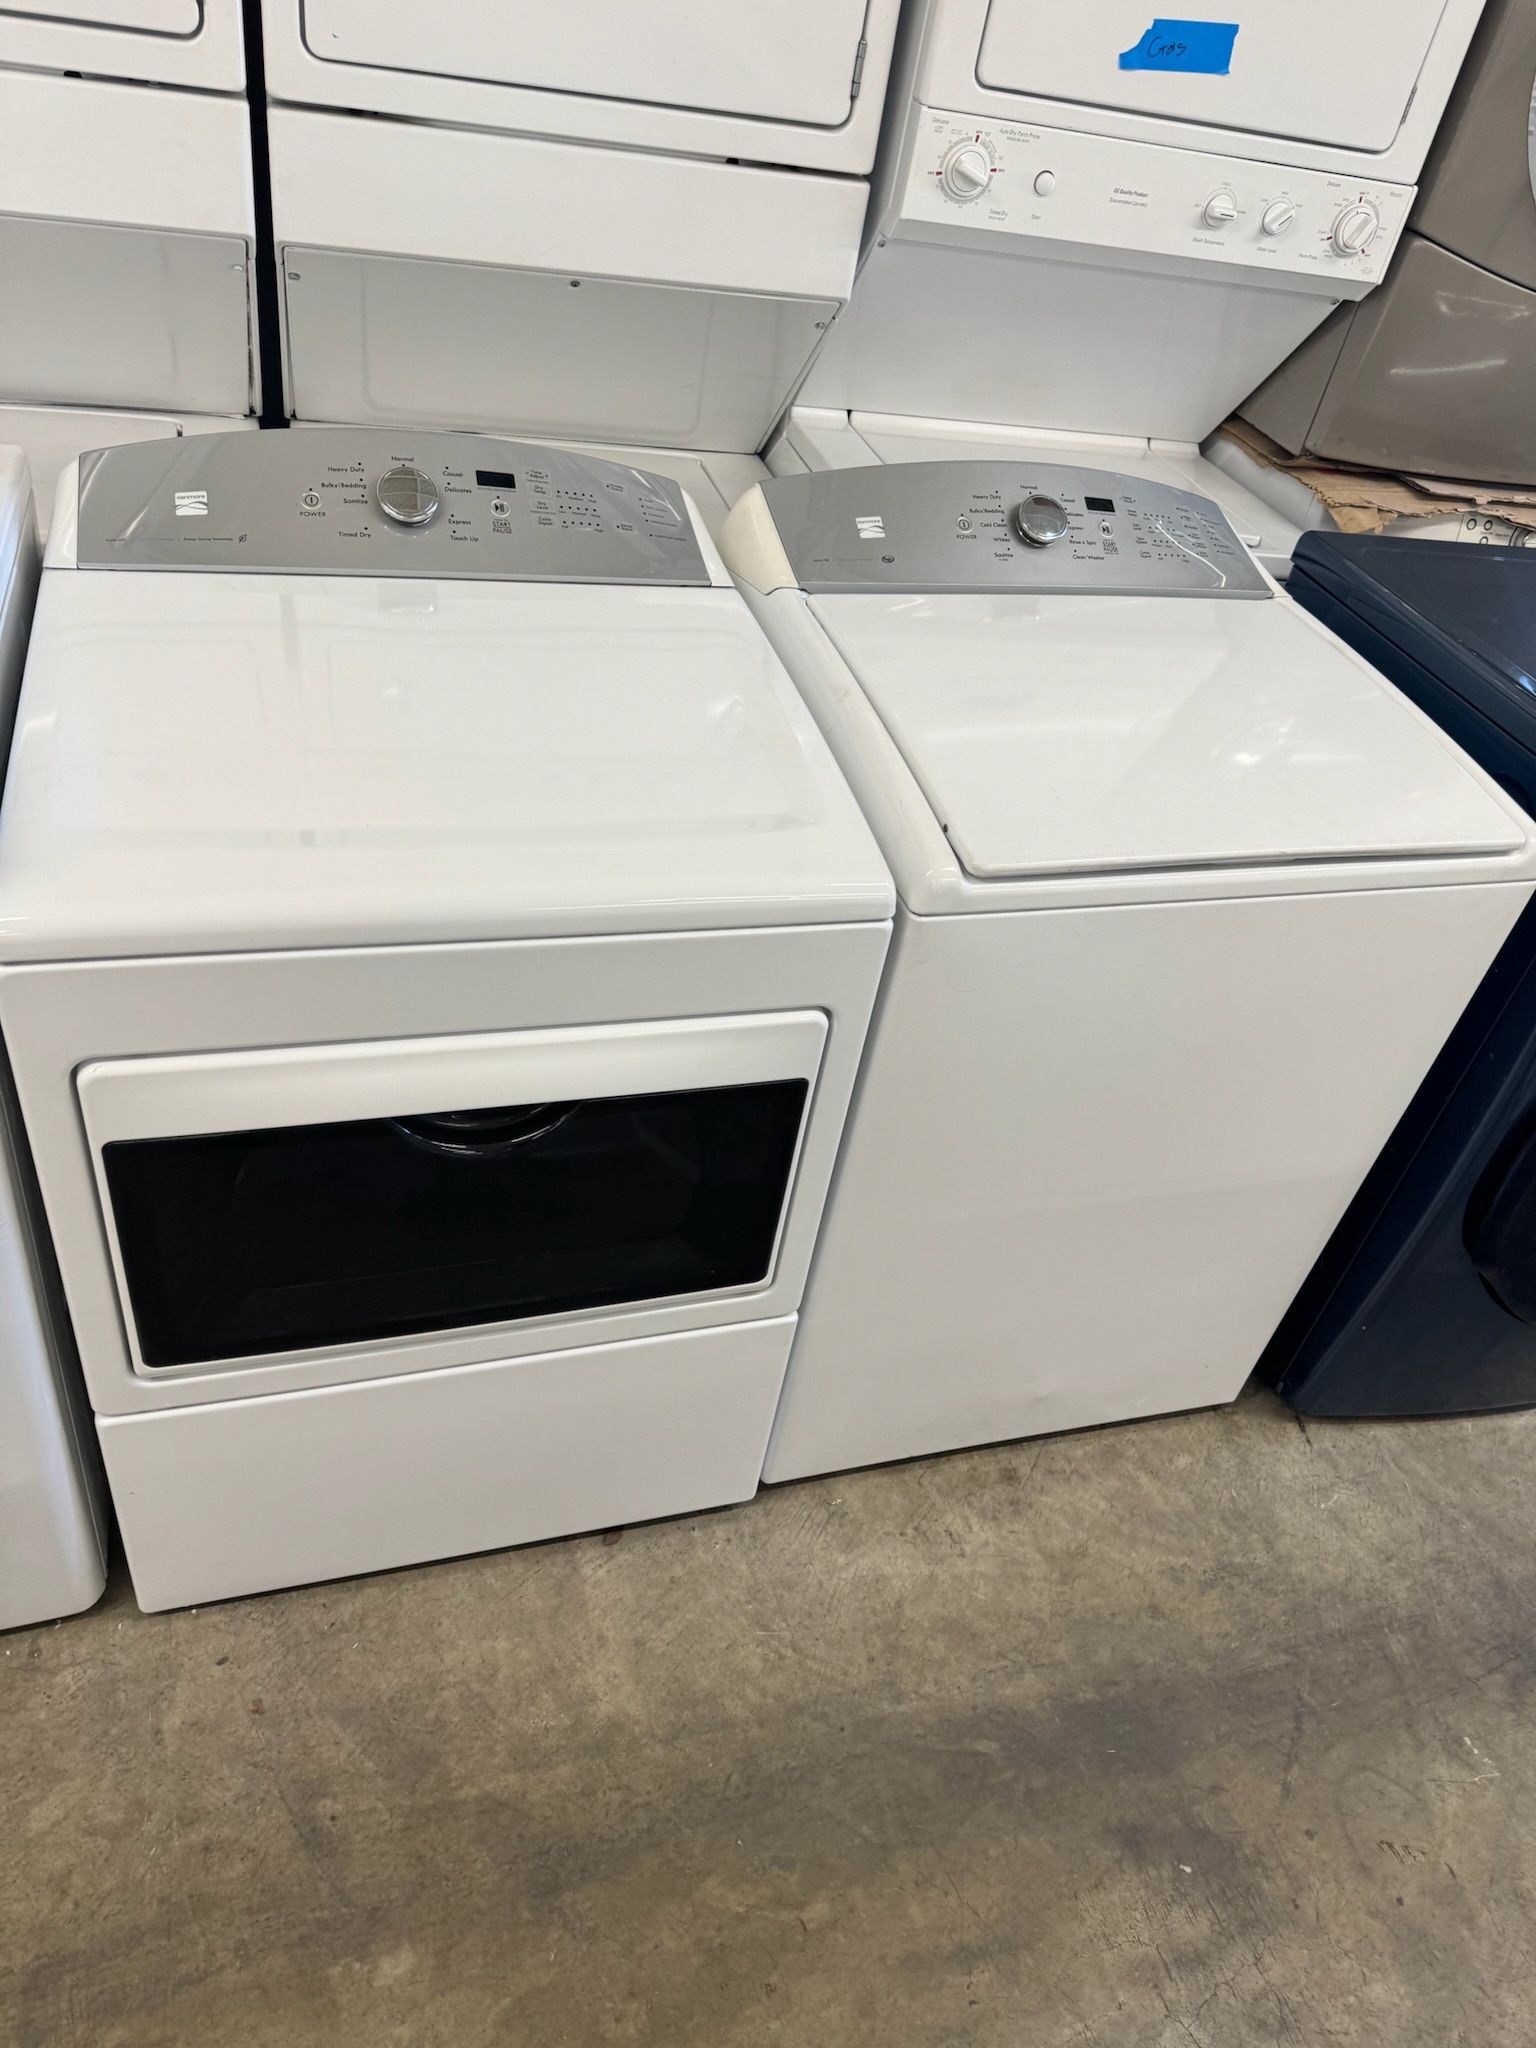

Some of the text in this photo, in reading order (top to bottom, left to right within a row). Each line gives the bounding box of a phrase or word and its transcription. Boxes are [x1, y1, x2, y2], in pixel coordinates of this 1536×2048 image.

[1147, 35, 1187, 58] Gas
[350, 466, 365, 474] Duty
[442, 470, 463, 478] Casual
[444, 486, 473, 494] Delicates
[448, 518, 472, 526] Express
